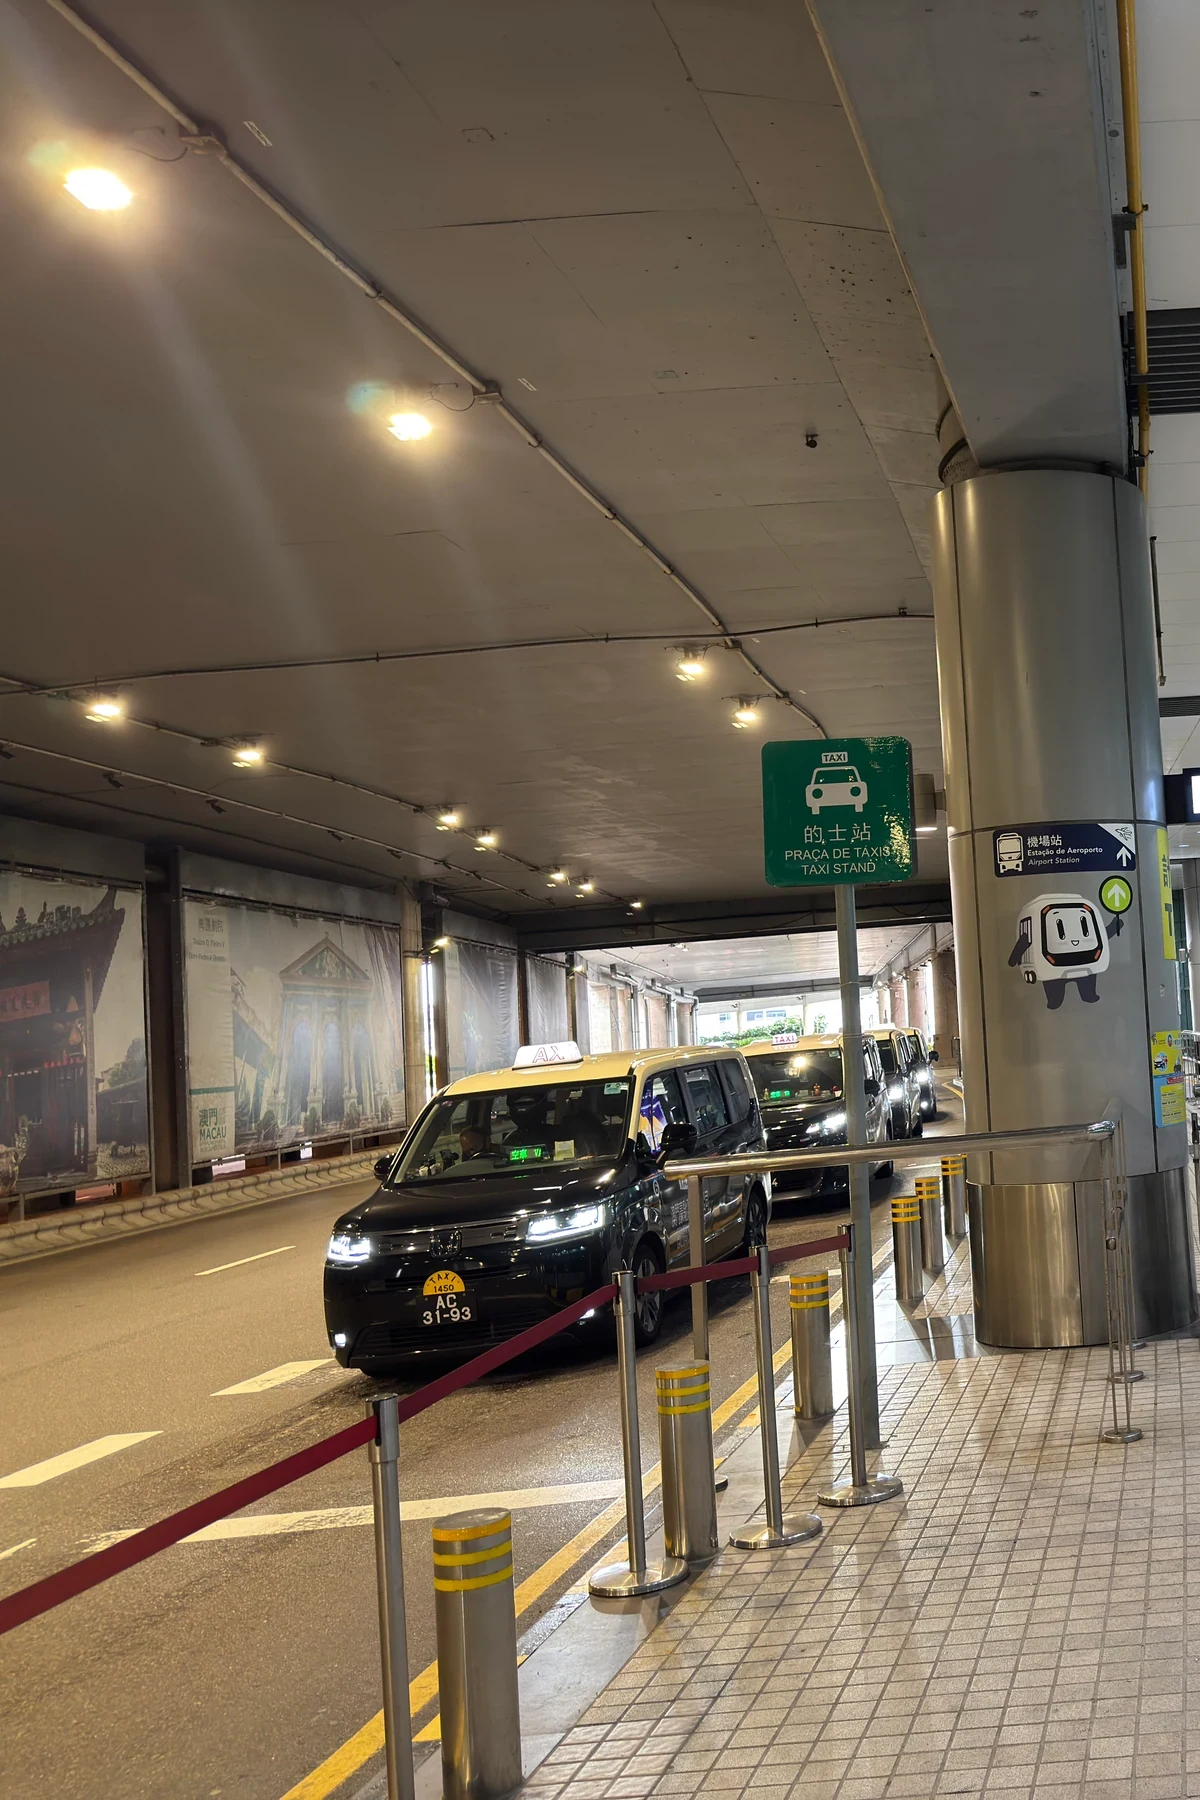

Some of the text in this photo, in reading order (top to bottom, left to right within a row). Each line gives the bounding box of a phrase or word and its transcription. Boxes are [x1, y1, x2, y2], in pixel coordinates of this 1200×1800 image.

[823, 753, 846, 762] TAXI
[804, 822, 871, 843] 的士站
[1027, 834, 1062, 848] 機場站
[785, 849, 829, 862] PRAÇA
[833, 847, 851, 859] DE
[1027, 849, 1054, 857] Estação
[1067, 847, 1103, 855] Aeroporto
[801, 862, 876, 875] TAXI STAND
[1028, 858, 1053, 866] Airport
[774, 1035, 794, 1043] TAXI
[199, 1108, 218, 1127] 澳門
[200, 1126, 226, 1140] MACAU
[429, 1272, 456, 1284] TAXI
[434, 1284, 454, 1293] 1450
[436, 1294, 457, 1309] AC
[423, 1306, 472, 1325] 31-93
